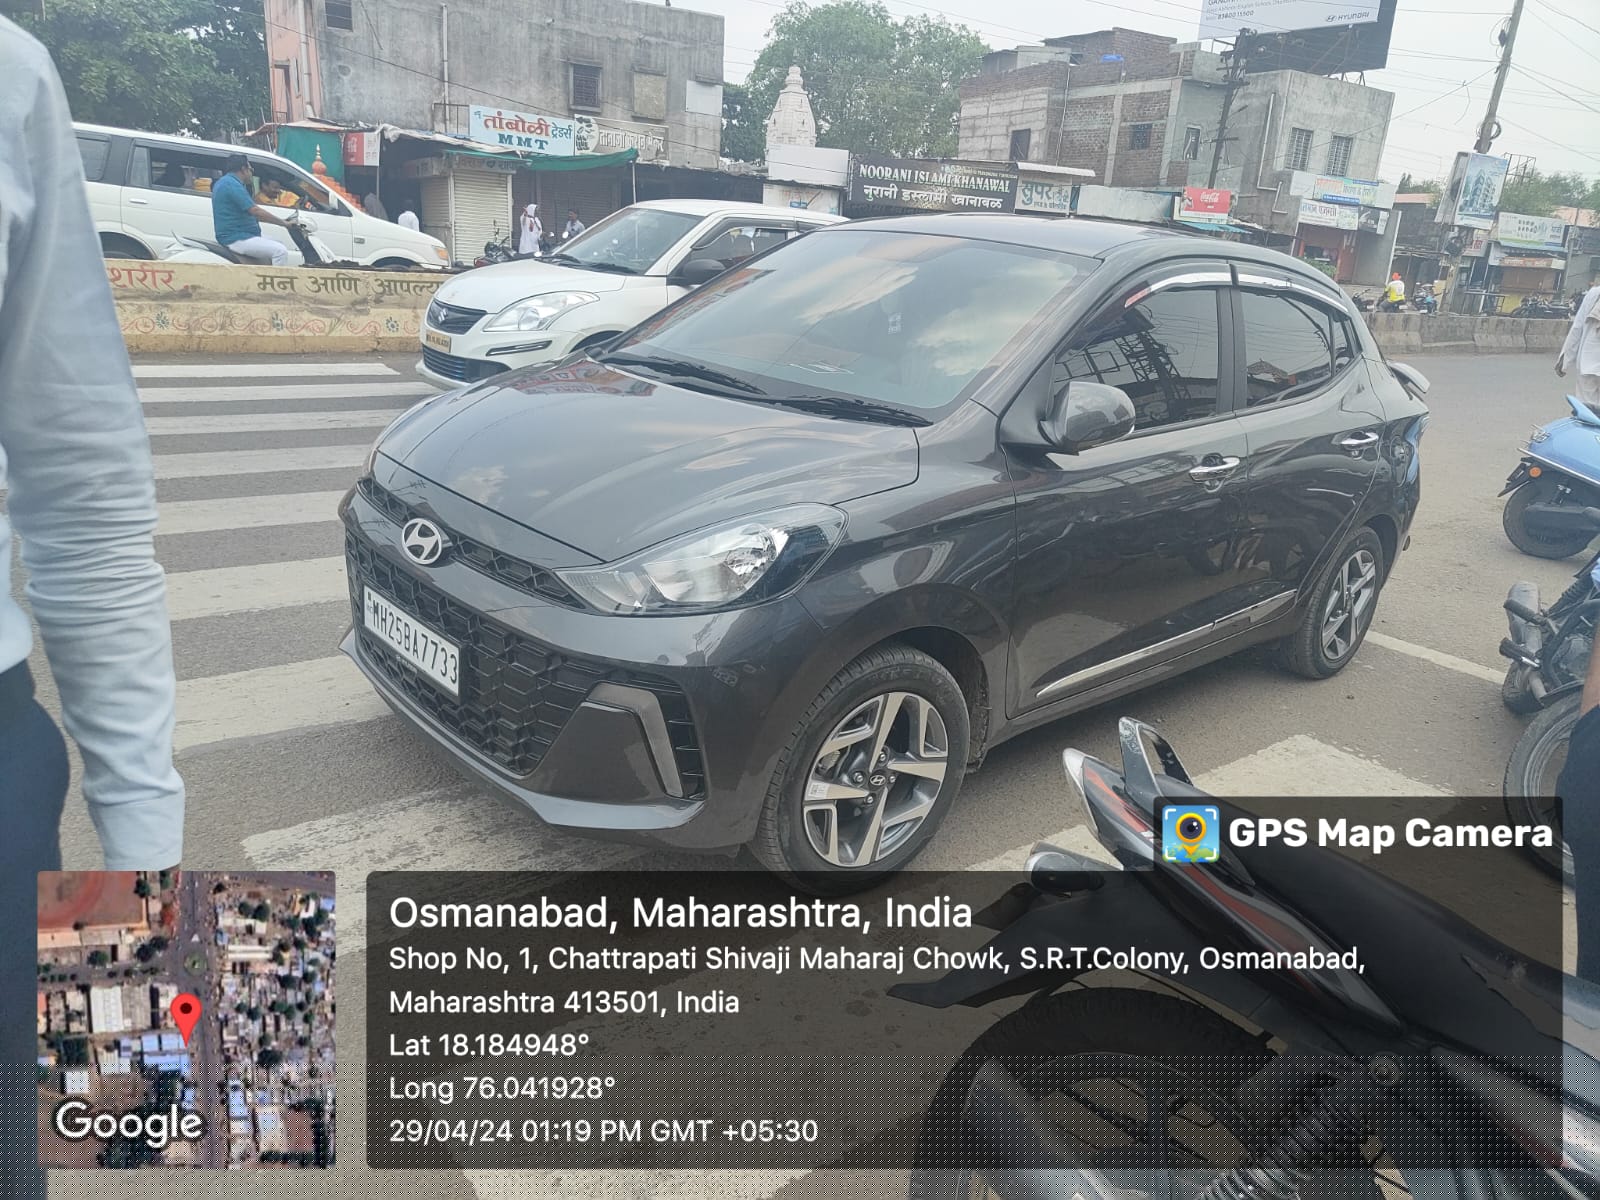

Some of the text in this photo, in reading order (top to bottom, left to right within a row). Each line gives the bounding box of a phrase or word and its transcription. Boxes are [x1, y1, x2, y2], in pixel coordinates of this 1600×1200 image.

[1338, 11, 1370, 21] HYUNDAI
[482, 110, 550, 137] तांबोळी
[859, 164, 912, 183] NOORANI
[913, 169, 953, 187] ISLAMI
[952, 174, 1010, 194] KHANAWAL
[951, 193, 1003, 209] खानावळ
[256, 274, 298, 294] मन
[306, 273, 360, 296] आणि
[371, 278, 445, 297] आपल्य
[372, 599, 458, 685] MH25BA7733
